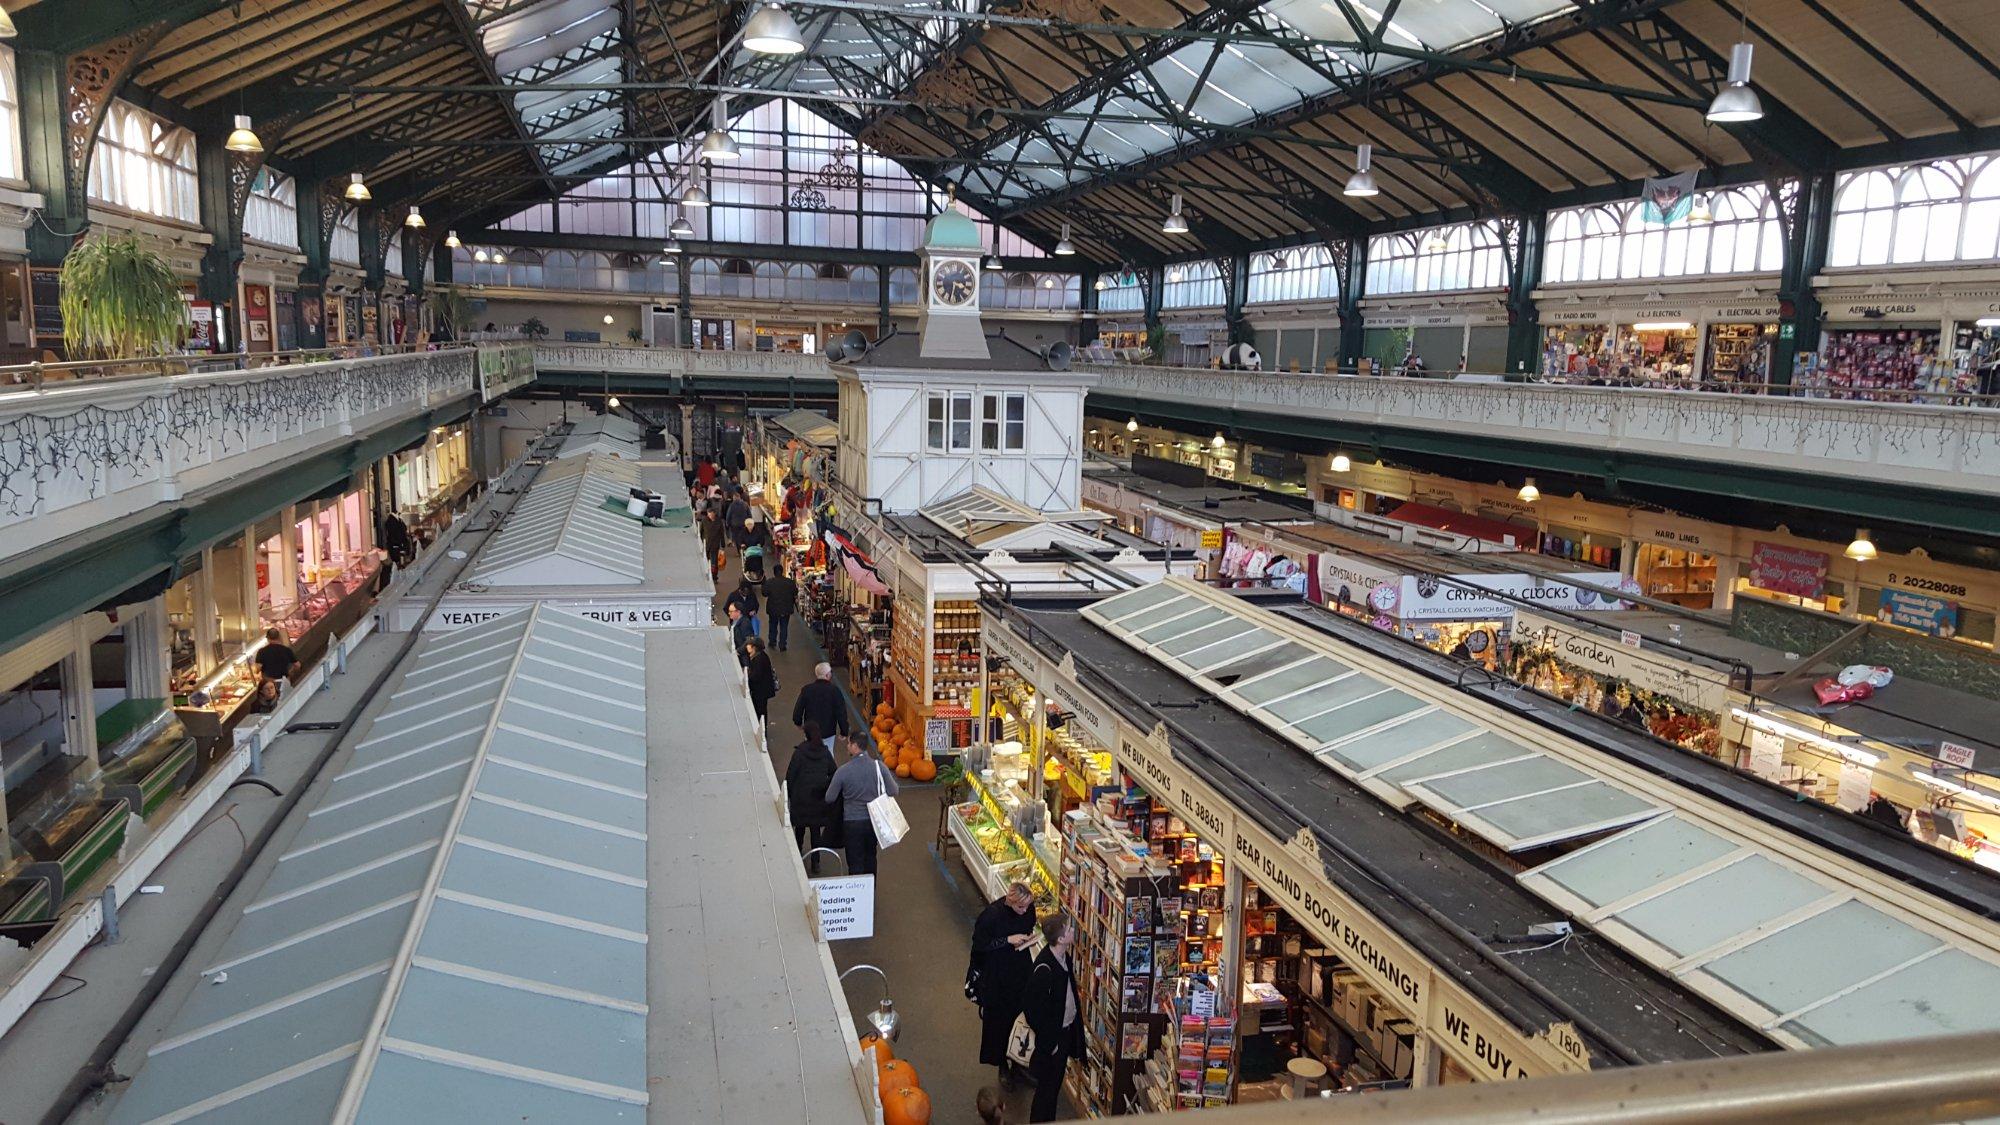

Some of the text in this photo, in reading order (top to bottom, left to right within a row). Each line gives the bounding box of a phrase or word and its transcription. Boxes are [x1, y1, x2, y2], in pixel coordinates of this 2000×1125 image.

[1727, 308, 1761, 316] ELECTRICAL
[1885, 305, 1916, 313] CABLES
[1655, 529, 1700, 544] HARD LINES
[1329, 565, 1357, 584] CRYSTALS
[1358, 574, 1364, 587] &
[1521, 587, 1569, 600] CLOCKS
[582, 610, 672, 623] RUIT & VEG
[1565, 636, 1615, 668] Garden
[1084, 707, 1099, 728] FOODS
[1943, 744, 1973, 759] FRAGILE
[1945, 752, 1967, 765] ROOF
[1121, 738, 1224, 838] WE BUY BOOKS TEL 388631
[1301, 833, 1316, 852] 178
[821, 896, 856, 905] eddings
[821, 906, 853, 915] unerals
[1236, 833, 1420, 1004] BEAR ISLAND BOOK EXCHANGE
[825, 925, 848, 933] vents
[1444, 1006, 1512, 1079] WE BUY
[1559, 1030, 1581, 1059] 180
